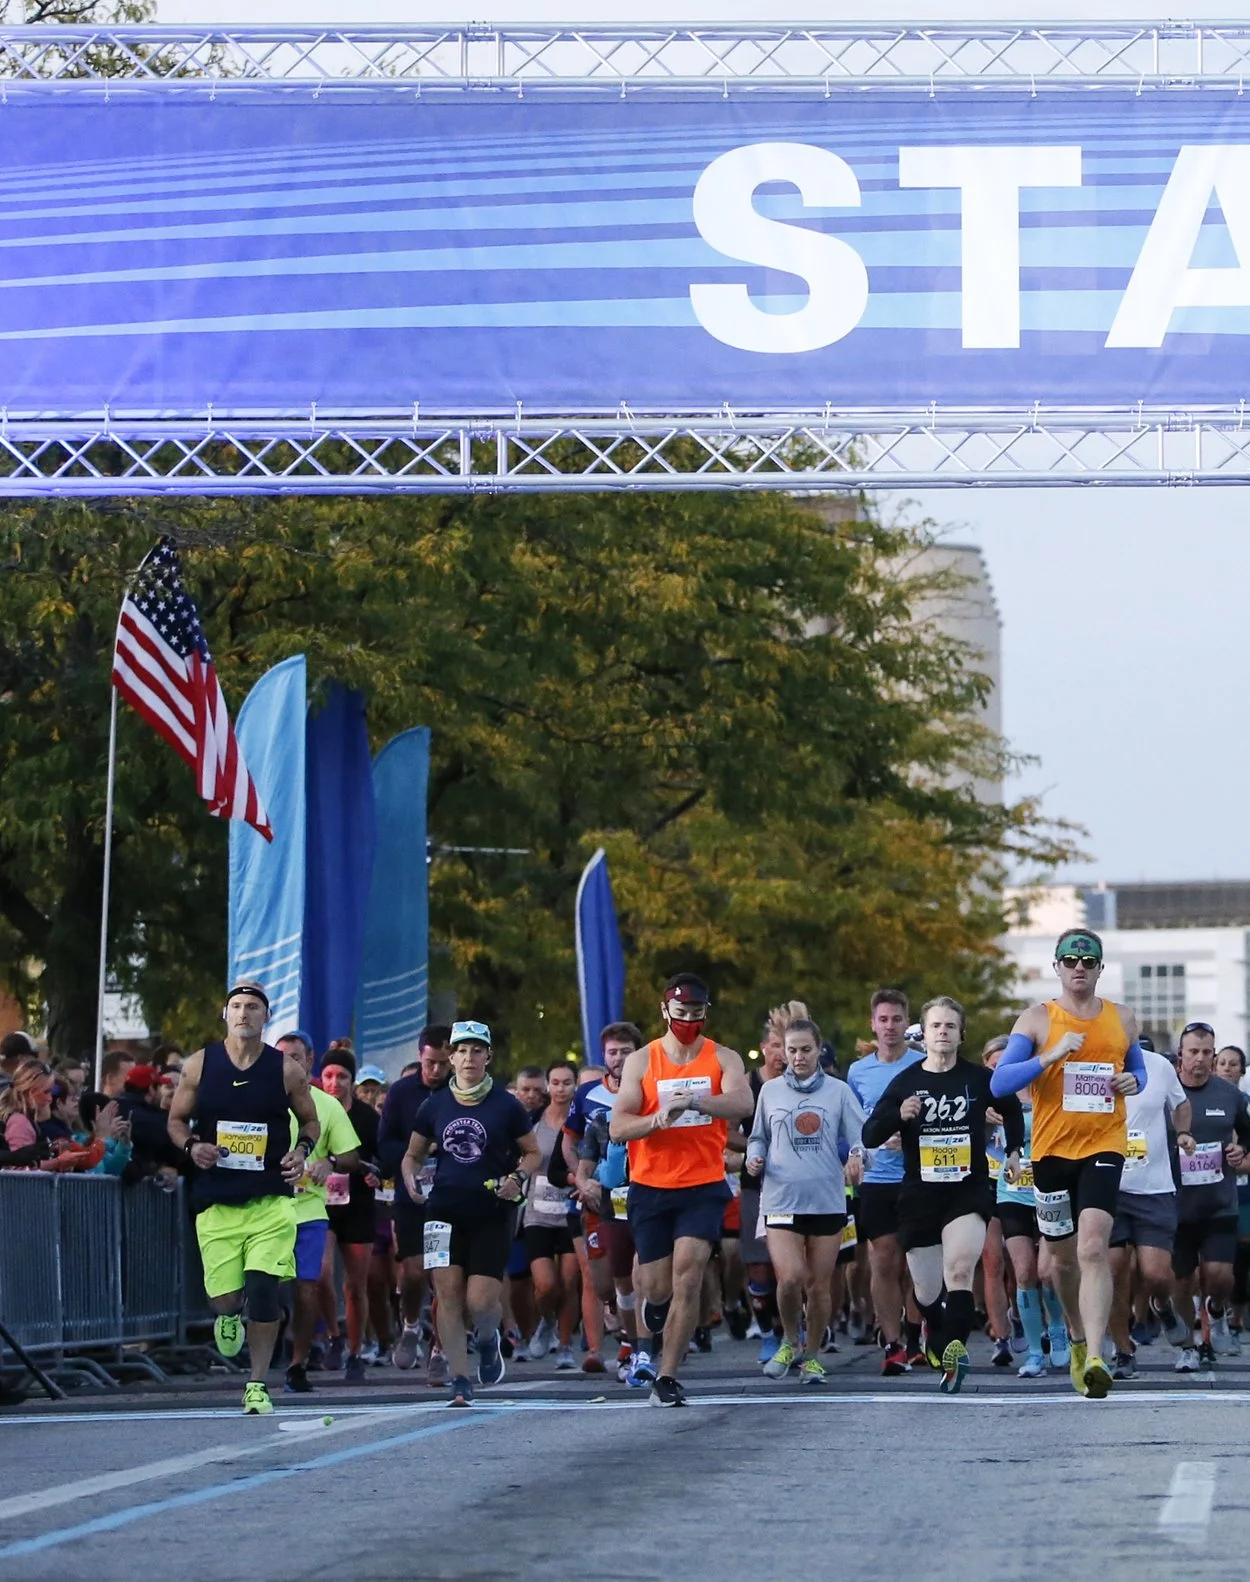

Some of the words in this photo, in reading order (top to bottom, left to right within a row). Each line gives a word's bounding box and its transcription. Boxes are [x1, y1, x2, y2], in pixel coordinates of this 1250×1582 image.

[1074, 1083, 1107, 1096] 8006
[924, 1094, 967, 1122] 26.2
[230, 1142, 254, 1154] 600
[933, 1154, 956, 1166] 611
[1189, 1160, 1217, 1172] 8166
